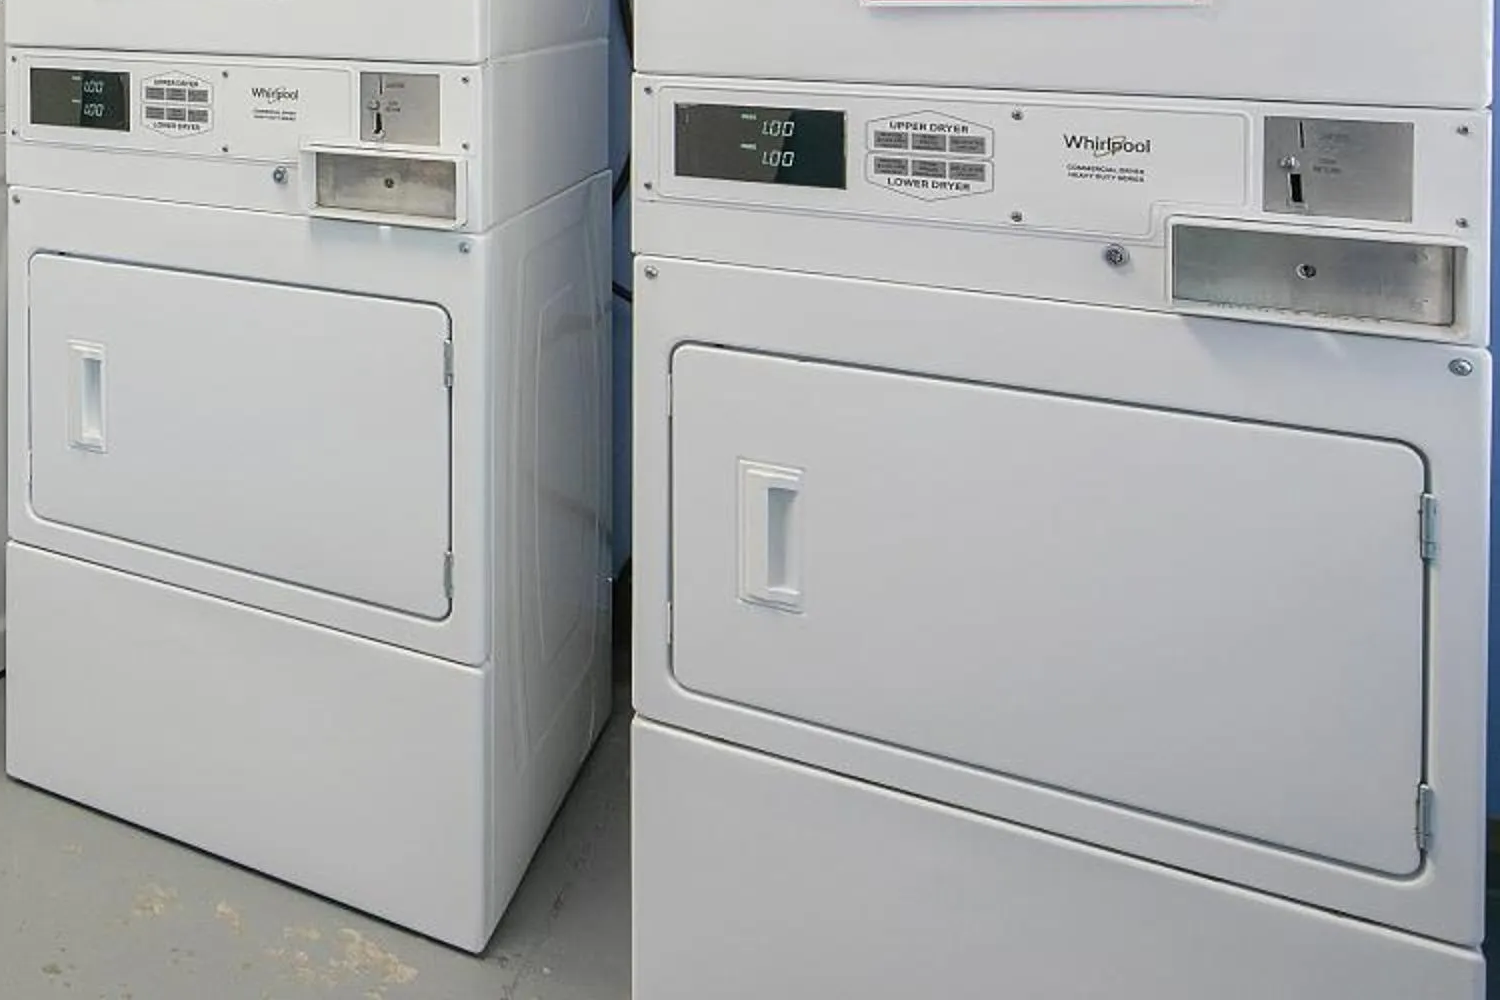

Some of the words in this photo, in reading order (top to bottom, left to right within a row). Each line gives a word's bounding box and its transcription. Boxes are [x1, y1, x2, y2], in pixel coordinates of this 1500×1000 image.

[251, 87, 299, 101] Whirlpool
[889, 121, 927, 131] UPPER
[929, 123, 969, 134] DRYER
[1063, 133, 1151, 156] Whirlpool
[887, 177, 929, 189] LOWER
[931, 180, 971, 192] DRYER
